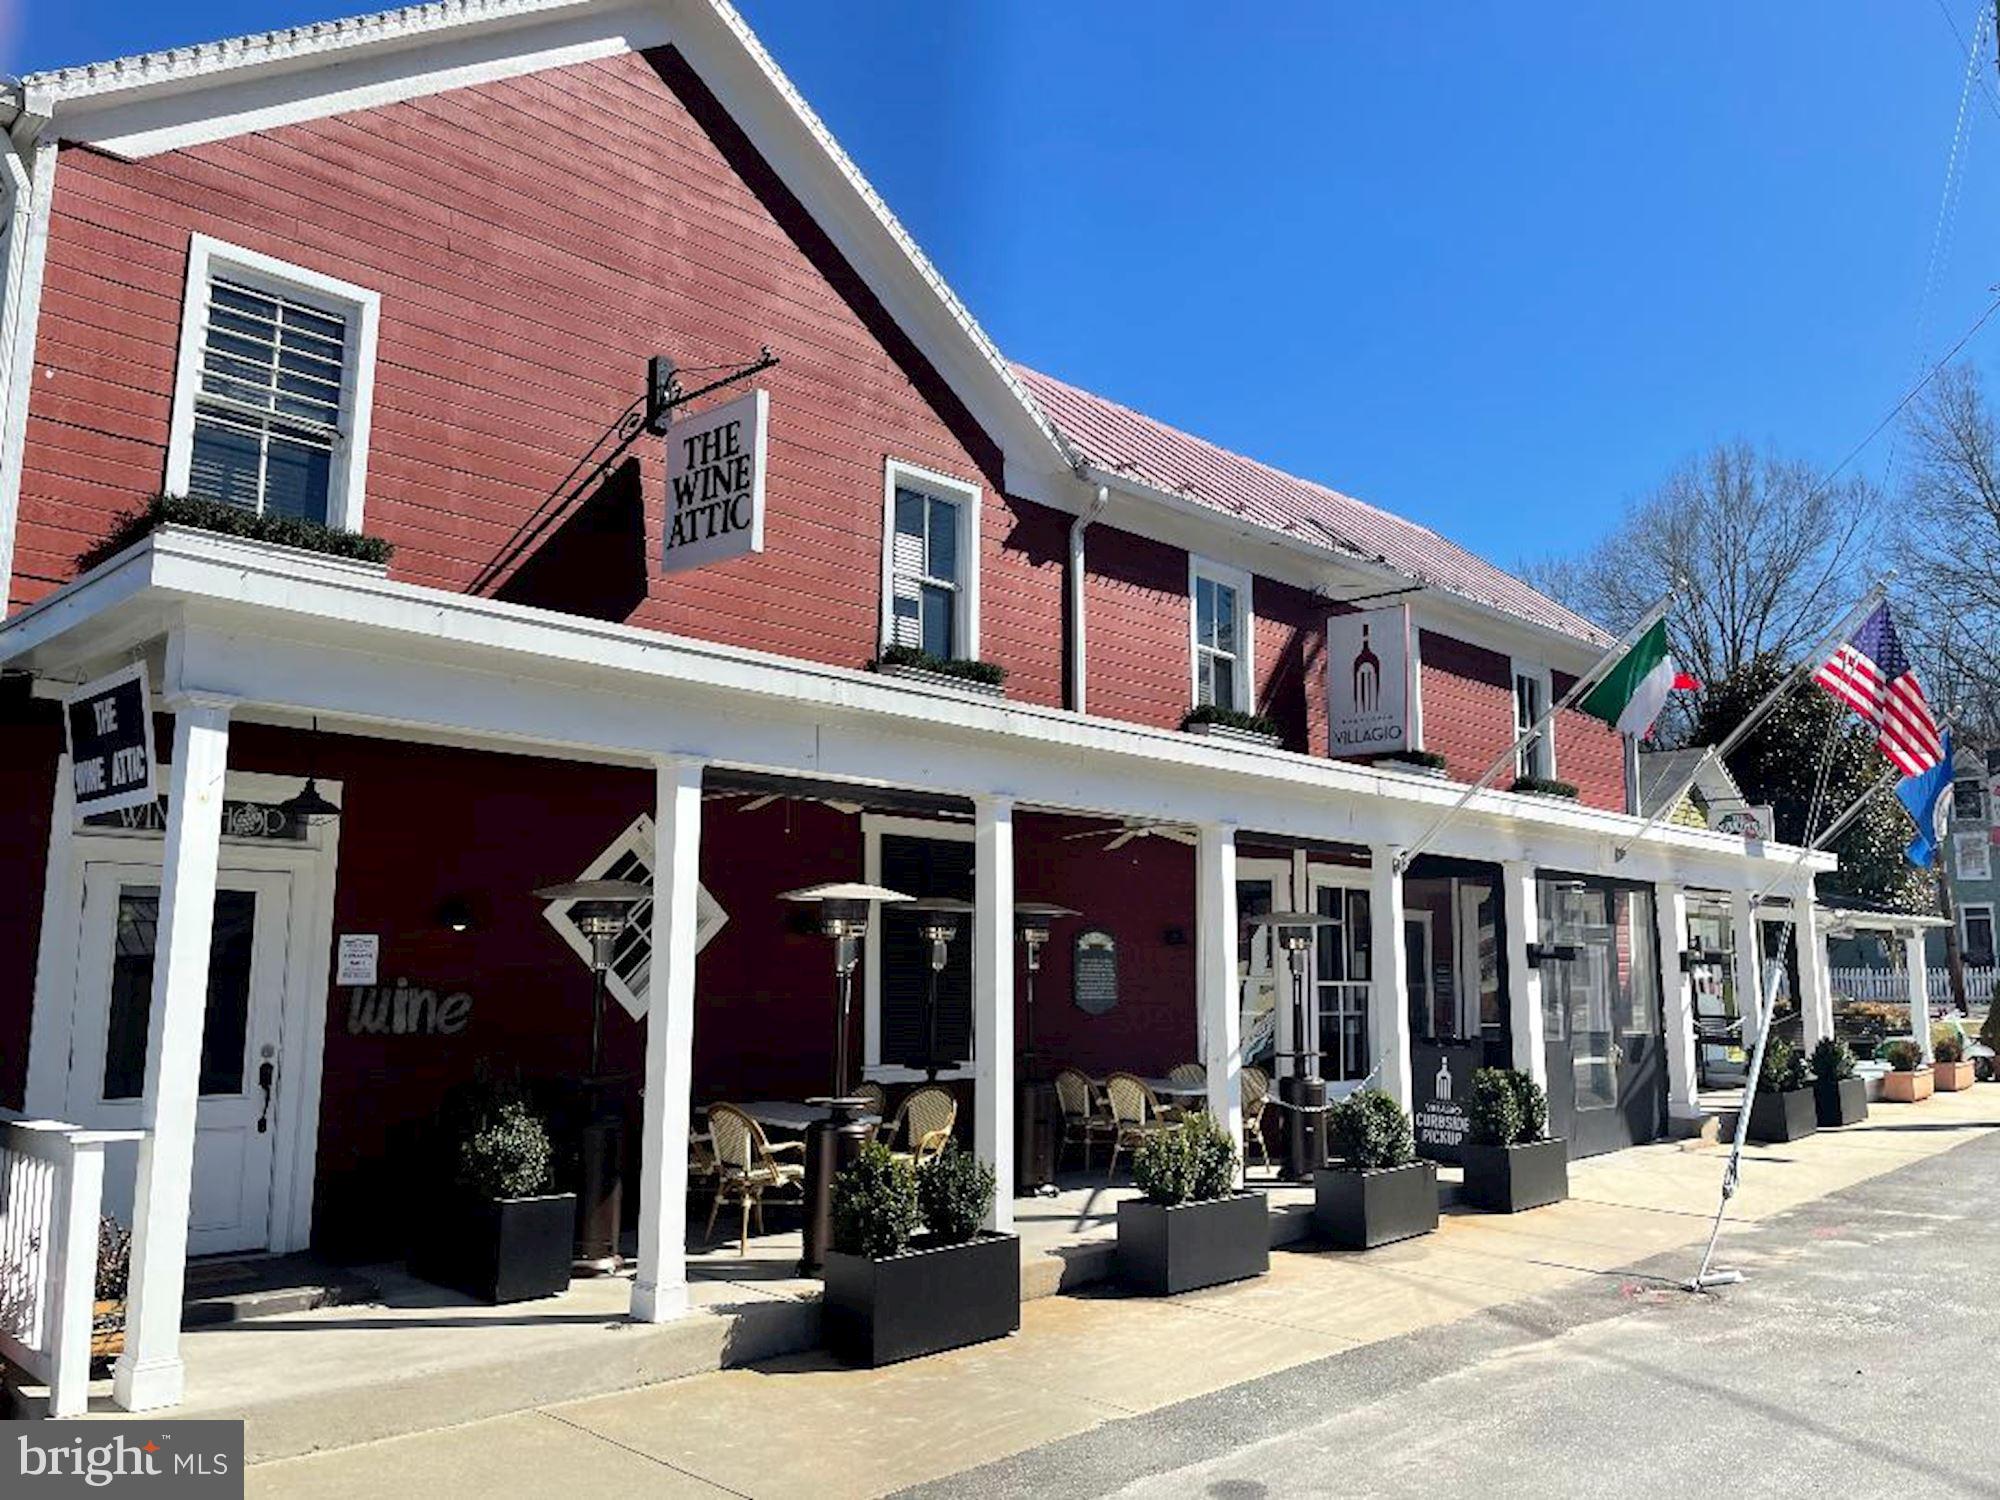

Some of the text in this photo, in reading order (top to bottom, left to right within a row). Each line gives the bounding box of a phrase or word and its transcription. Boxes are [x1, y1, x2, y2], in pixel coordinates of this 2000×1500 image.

[684, 420, 740, 471] THE
[672, 453, 750, 510] WINE
[666, 492, 750, 550] ATTIC
[93, 697, 118, 736] THE
[1332, 725, 1402, 745] VILLAGIO
[75, 744, 145, 795] WINE ATTIC
[120, 801, 287, 835] WIN HOP
[348, 977, 474, 1035] wine
[1416, 1112, 1471, 1133] CURBSIDE
[1422, 1128, 1463, 1146] PICKUP
